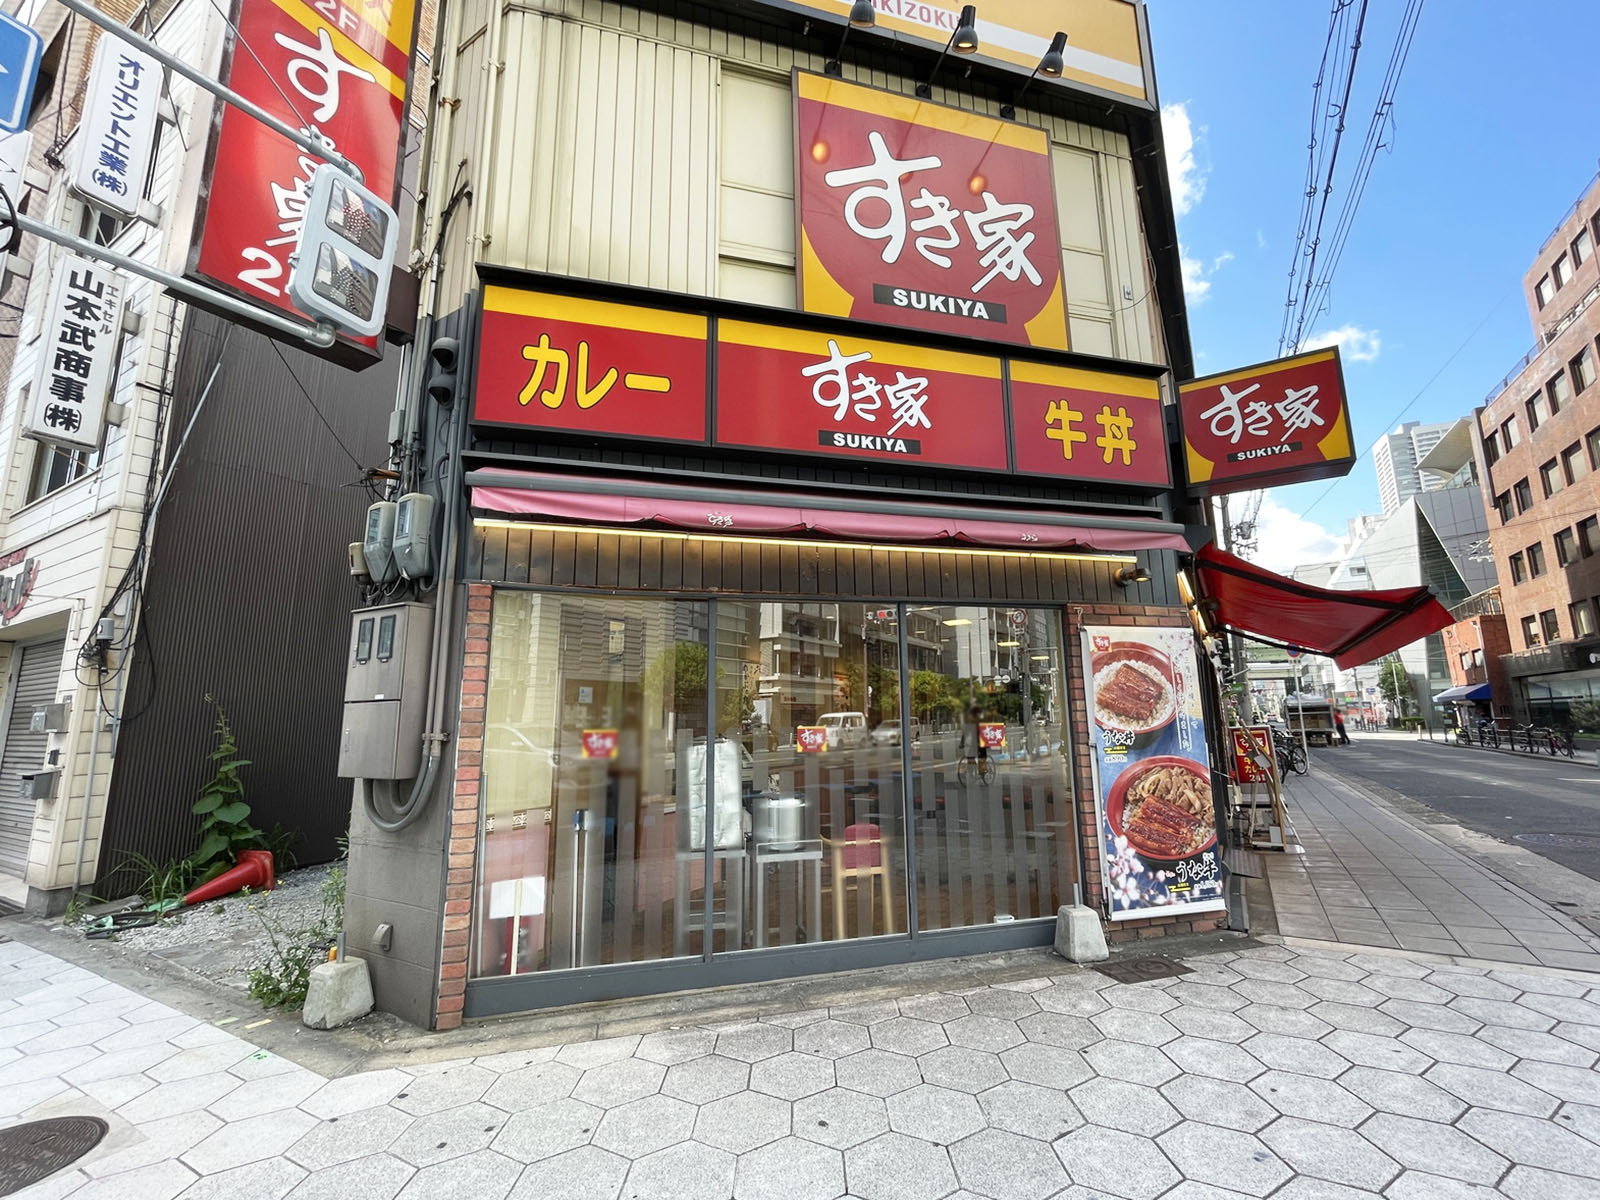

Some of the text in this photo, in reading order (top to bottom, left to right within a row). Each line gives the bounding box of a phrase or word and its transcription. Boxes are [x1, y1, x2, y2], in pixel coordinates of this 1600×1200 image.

[824, 130, 1043, 294] すき家
[99, 284, 120, 336] エキセル
[892, 288, 990, 320] SUKIYA
[517, 332, 671, 410] カレー
[801, 339, 932, 436] すき家
[1199, 382, 1325, 444] すき家
[833, 432, 908, 453] SUKIYA
[1236, 443, 1292, 461] SUKIYA
